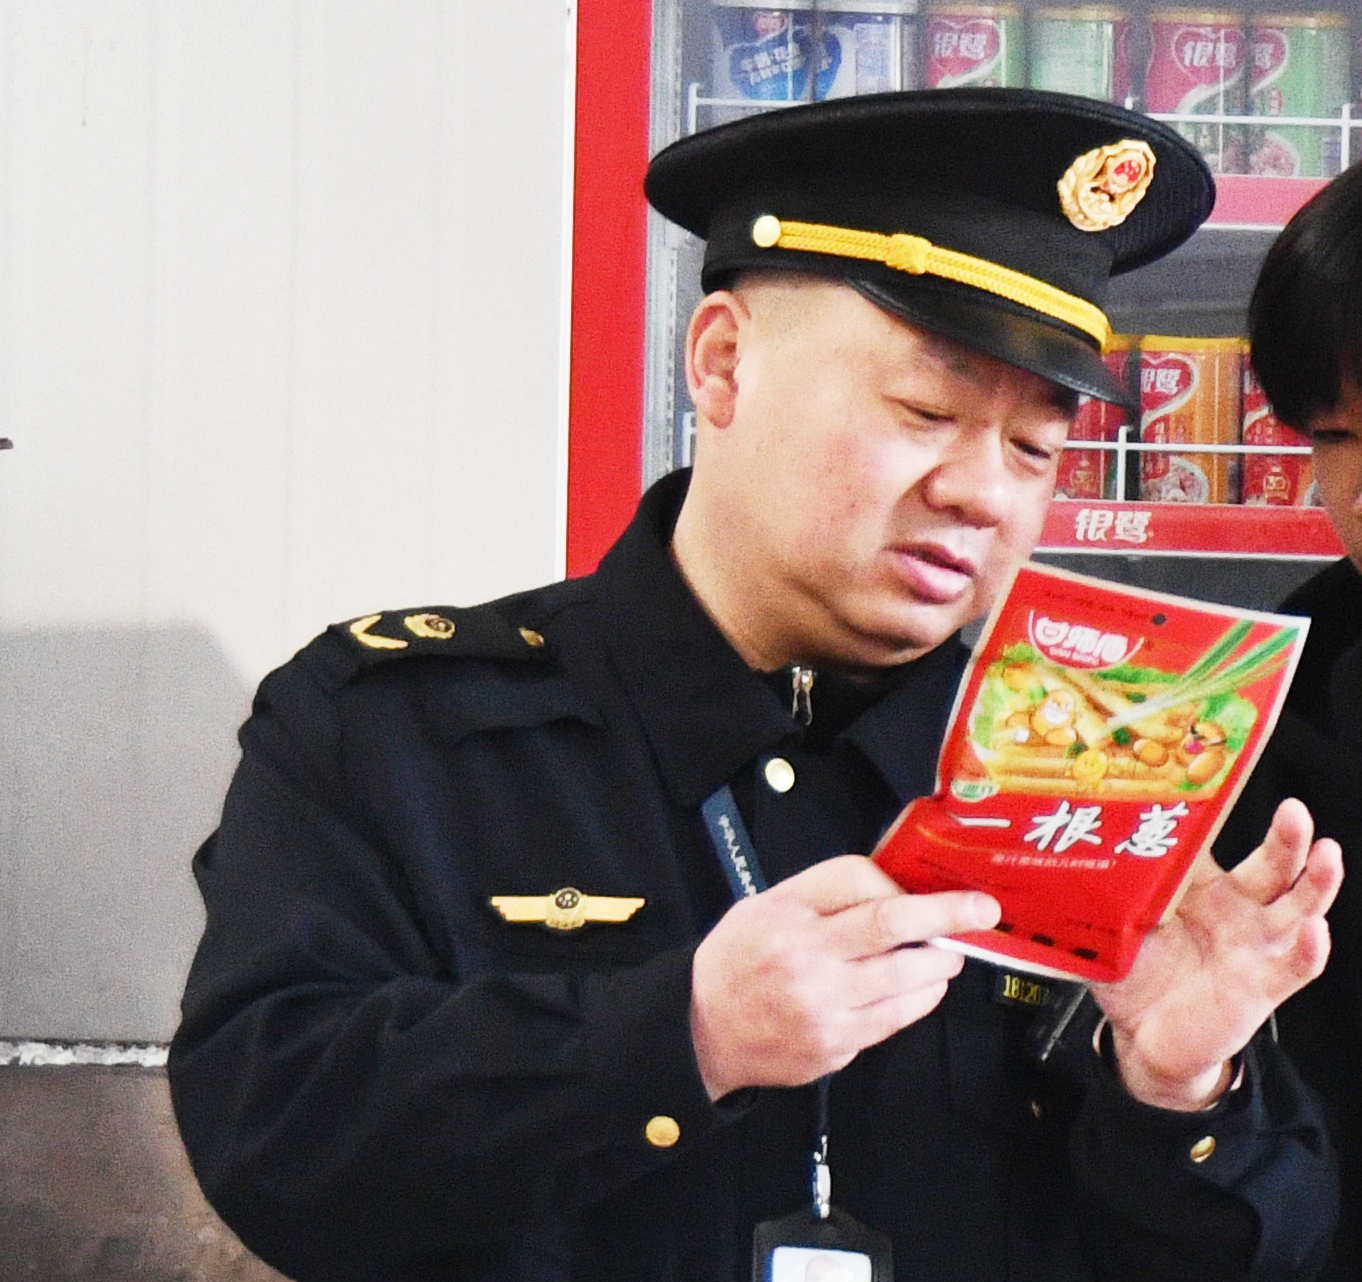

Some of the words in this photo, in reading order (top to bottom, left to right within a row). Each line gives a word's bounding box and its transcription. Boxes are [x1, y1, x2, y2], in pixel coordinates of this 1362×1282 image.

[1074, 508, 1153, 543] 银鹭
[953, 800, 1189, 857] 一根葱
